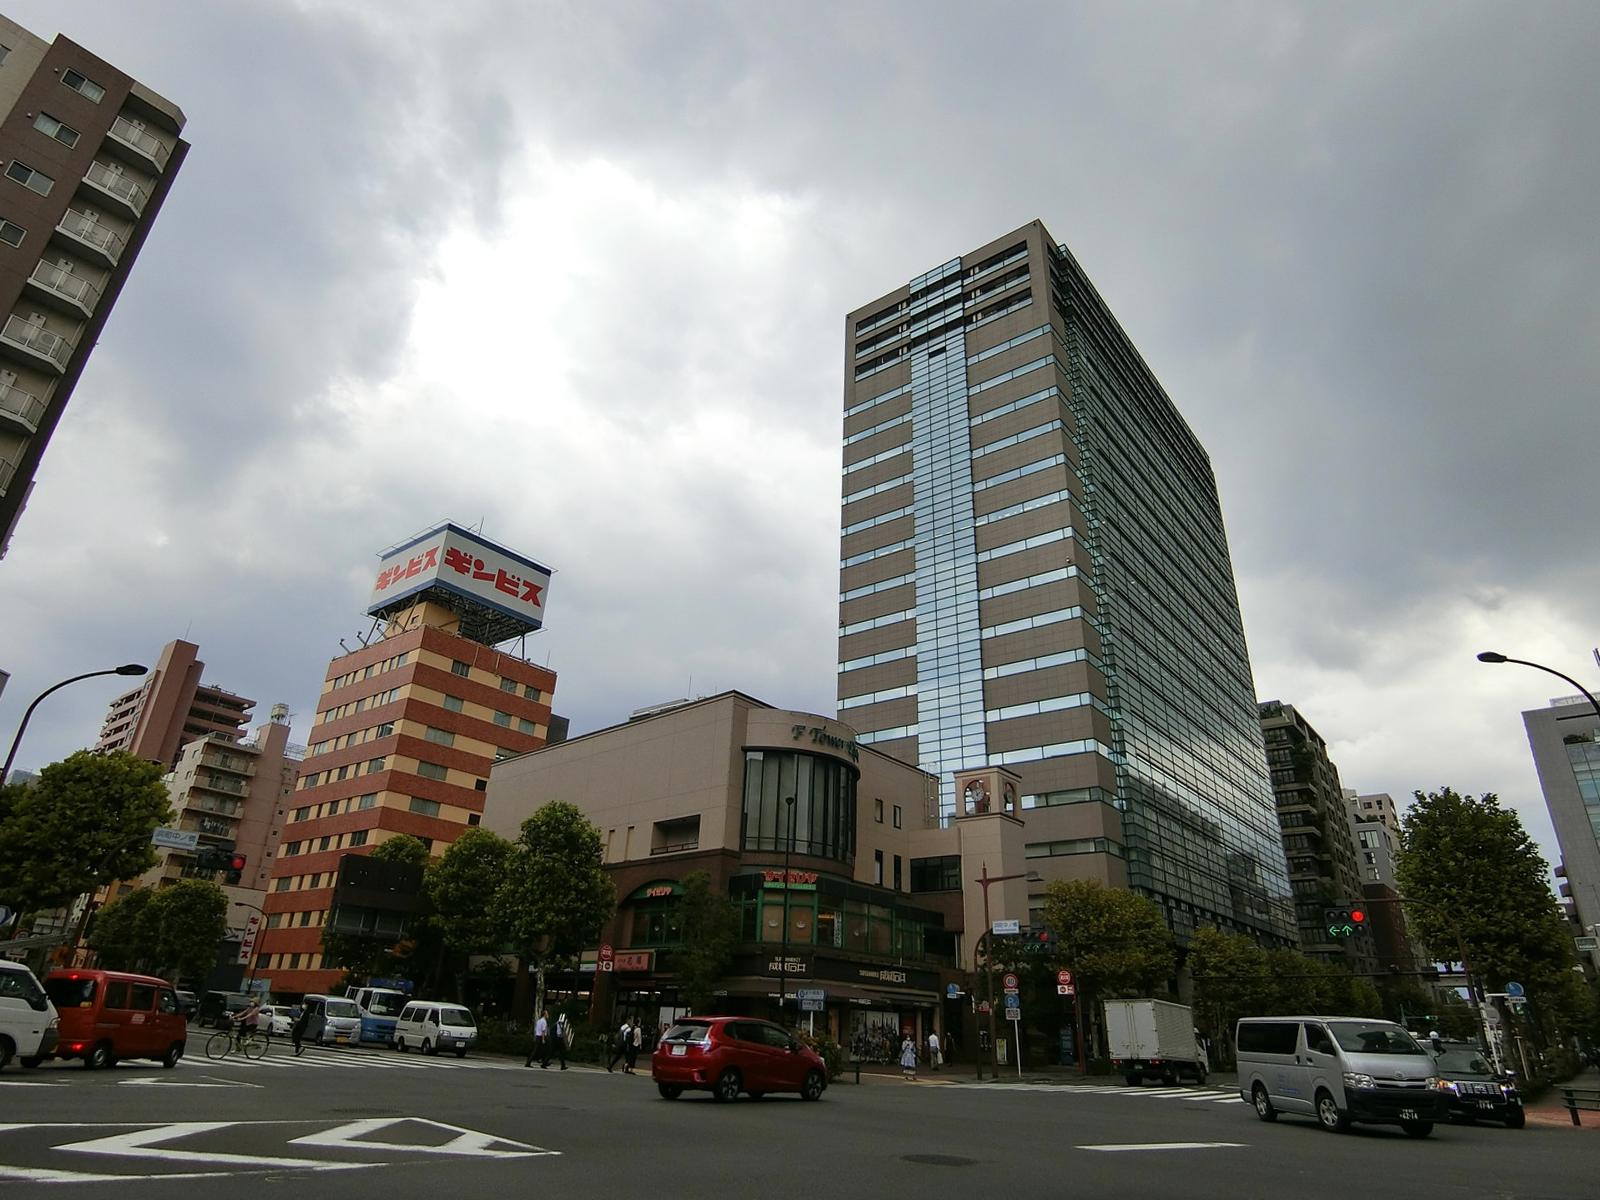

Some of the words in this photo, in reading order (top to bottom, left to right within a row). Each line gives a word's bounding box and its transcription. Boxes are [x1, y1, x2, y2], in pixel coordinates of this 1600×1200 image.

[375, 546, 441, 591] ギンビス
[444, 547, 544, 608] ギンビス
[763, 870, 819, 884] サイゼリヤ
[241, 917, 259, 959] ギンビス
